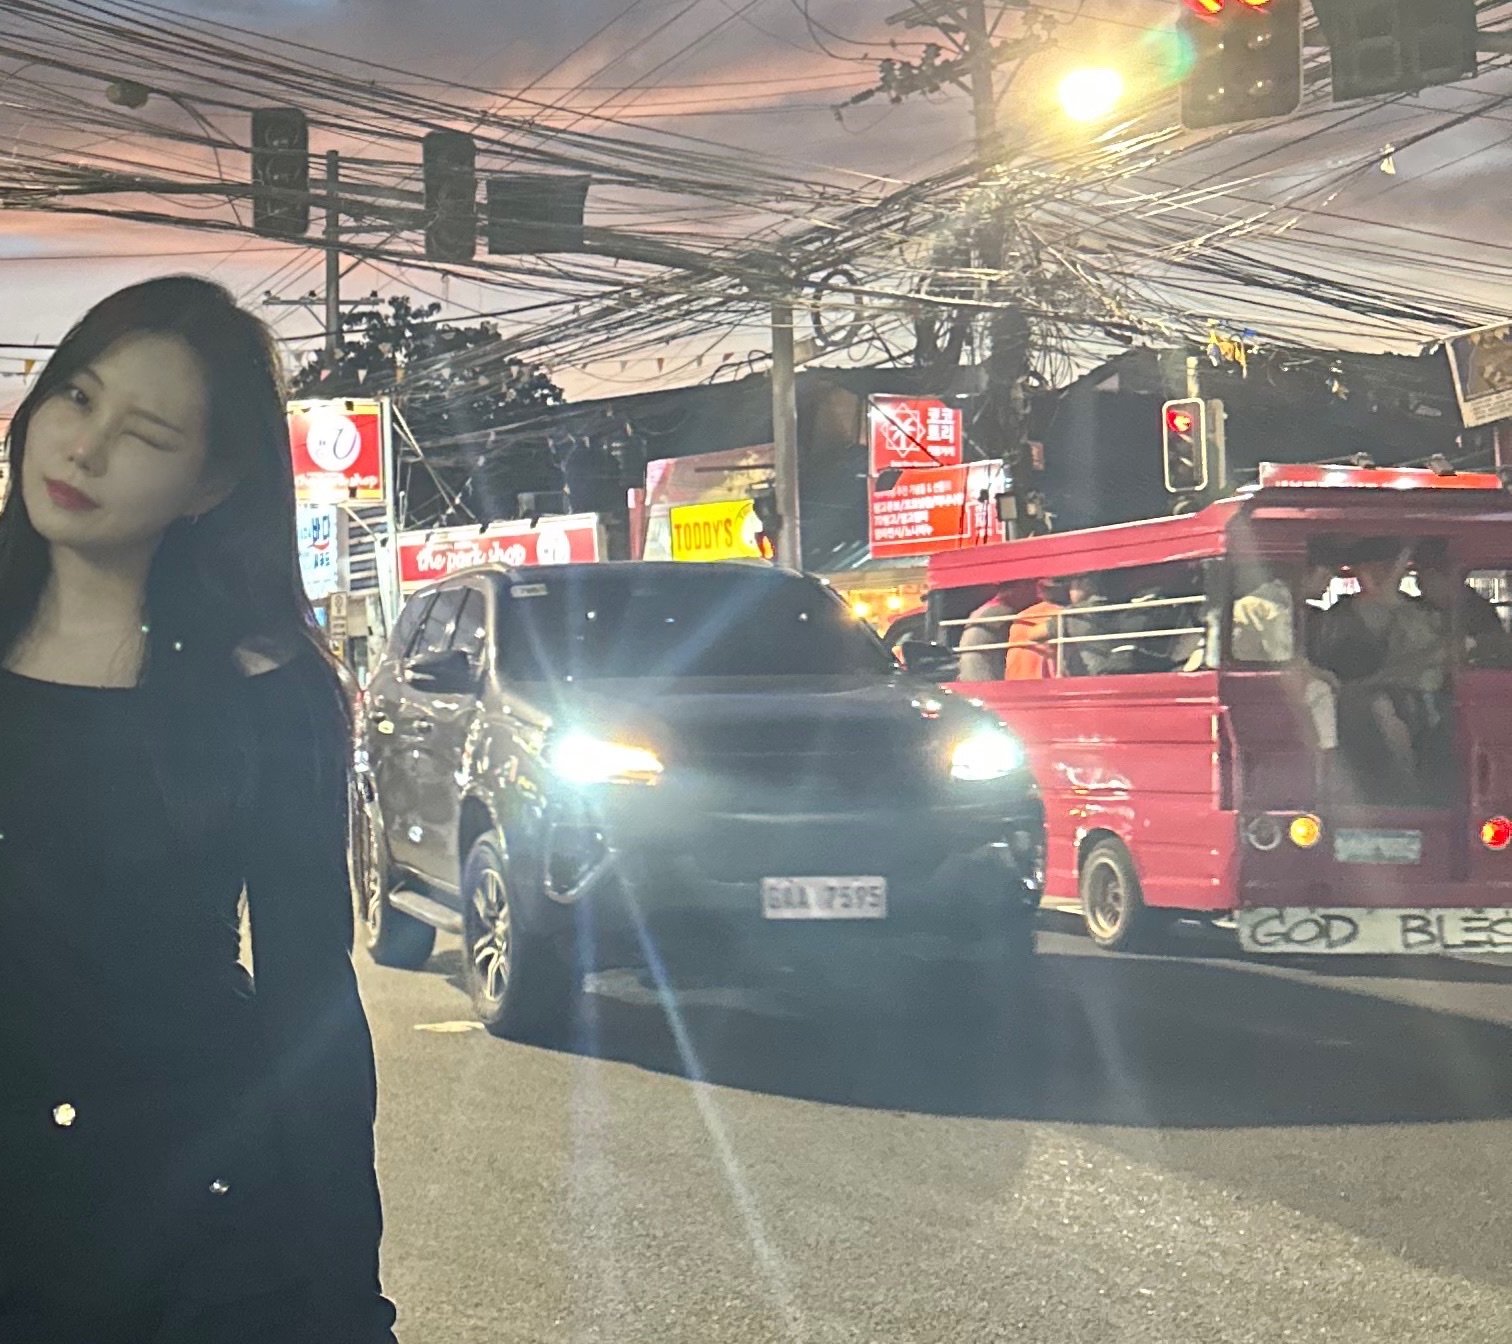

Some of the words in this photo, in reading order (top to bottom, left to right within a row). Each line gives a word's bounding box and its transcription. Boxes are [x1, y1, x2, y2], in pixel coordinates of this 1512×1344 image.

[674, 518, 733, 552] TODDY'S
[416, 542, 446, 572] the
[1251, 913, 1358, 949] GOD
